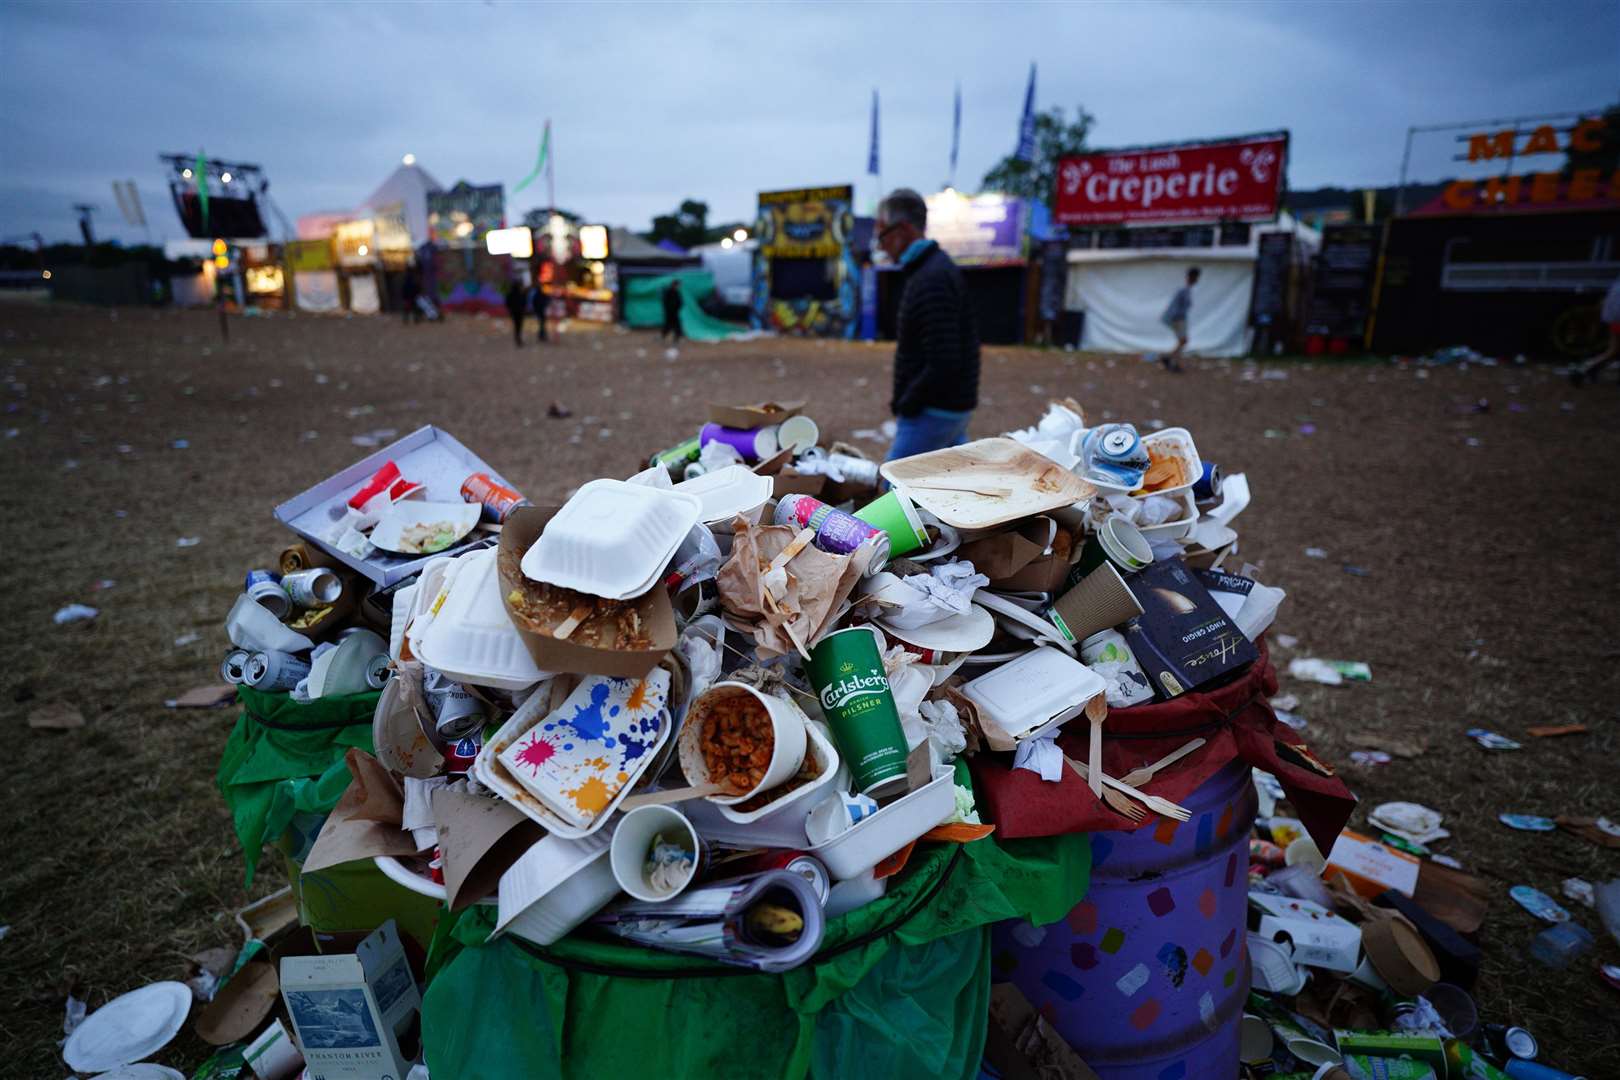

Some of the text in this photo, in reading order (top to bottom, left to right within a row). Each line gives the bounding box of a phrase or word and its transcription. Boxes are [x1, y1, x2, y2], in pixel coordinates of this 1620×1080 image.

[1468, 116, 1607, 165] MAC
[1085, 162, 1239, 208] Creperie
[1443, 169, 1620, 209] CHEE
[1182, 619, 1227, 643] PINOT GRIGIO
[1183, 636, 1243, 668] House
[821, 674, 889, 710] Carlsberg
[841, 698, 882, 718] PILSNER
[310, 1051, 382, 1060] PHANTOM RIVER
